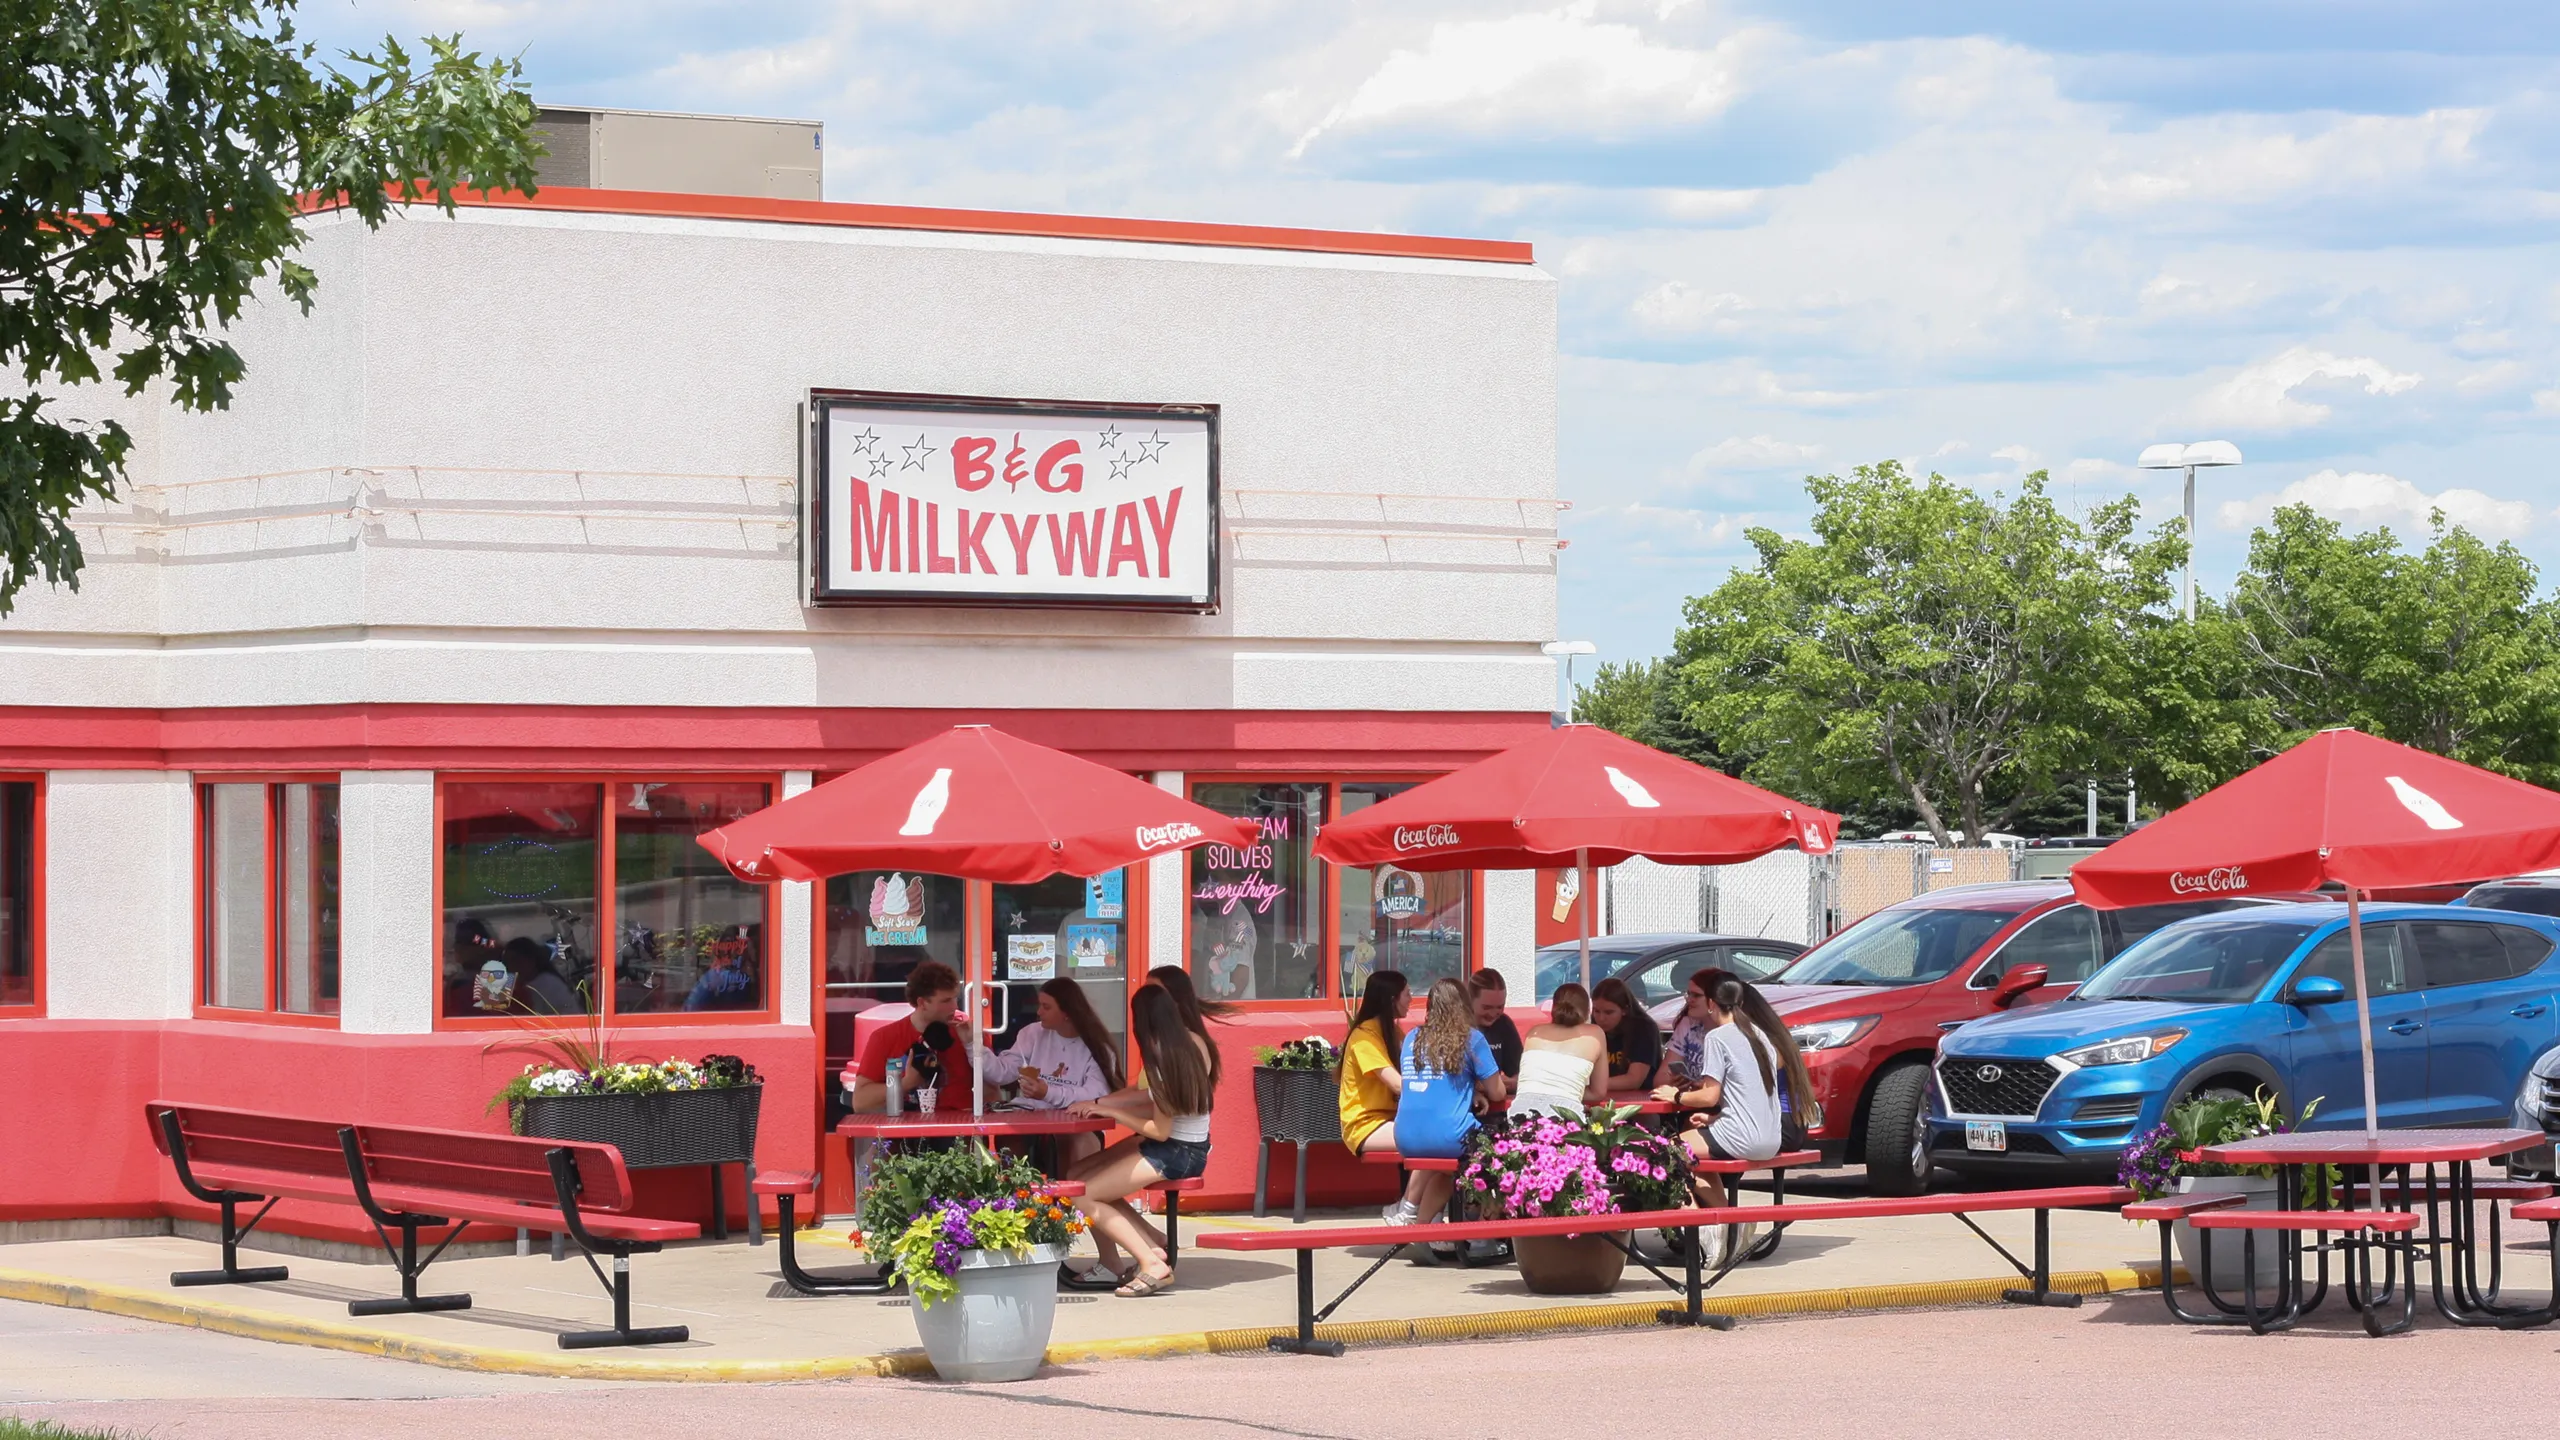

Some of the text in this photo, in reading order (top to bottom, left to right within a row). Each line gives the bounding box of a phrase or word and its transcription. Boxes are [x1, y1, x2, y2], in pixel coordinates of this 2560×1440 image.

[950, 431, 1084, 494] B&G
[850, 475, 1184, 579] MILKYWAY
[1136, 822, 1204, 851] Coca-Cola
[1393, 824, 1461, 852] Coca-Cola
[1207, 844, 1272, 870] SOLVES
[1192, 870, 1286, 915] everything
[2170, 866, 2250, 895] Coca-Cola
[1381, 896, 1419, 914] AMERICA
[865, 925, 928, 947] ICE CREAM
